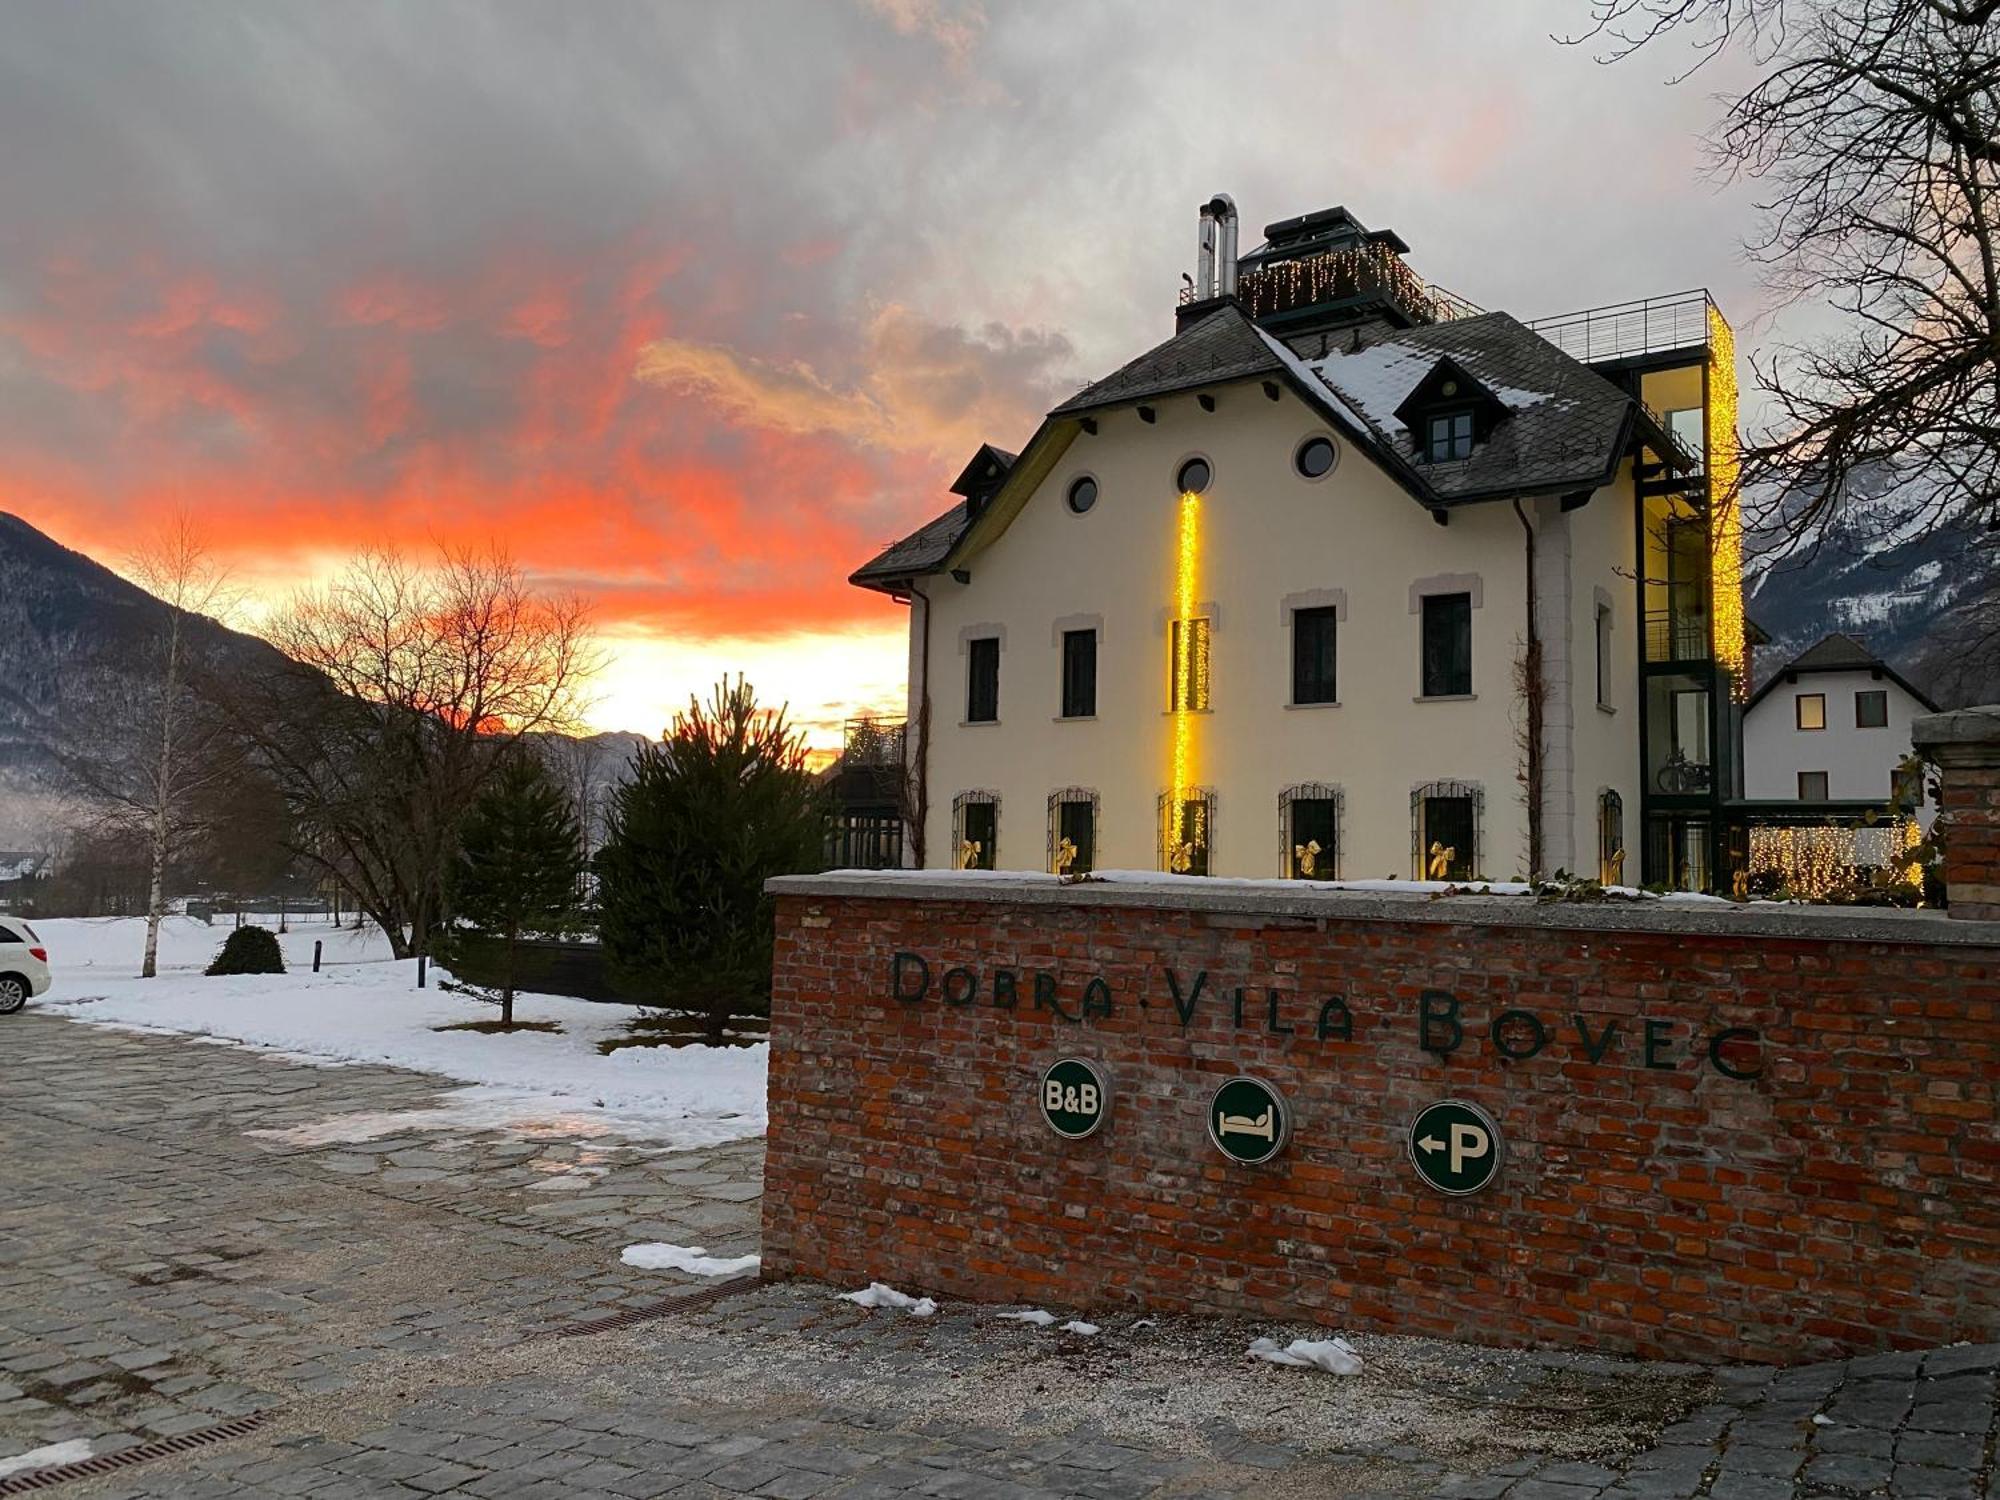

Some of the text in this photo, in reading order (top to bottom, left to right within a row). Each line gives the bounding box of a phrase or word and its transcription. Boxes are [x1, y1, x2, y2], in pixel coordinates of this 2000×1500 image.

[1164, 967, 1353, 1042] VILA
[1419, 990, 1765, 1081] BOVEC
[1045, 1079, 1098, 1115] B&B
[1450, 1123, 1489, 1174] P
